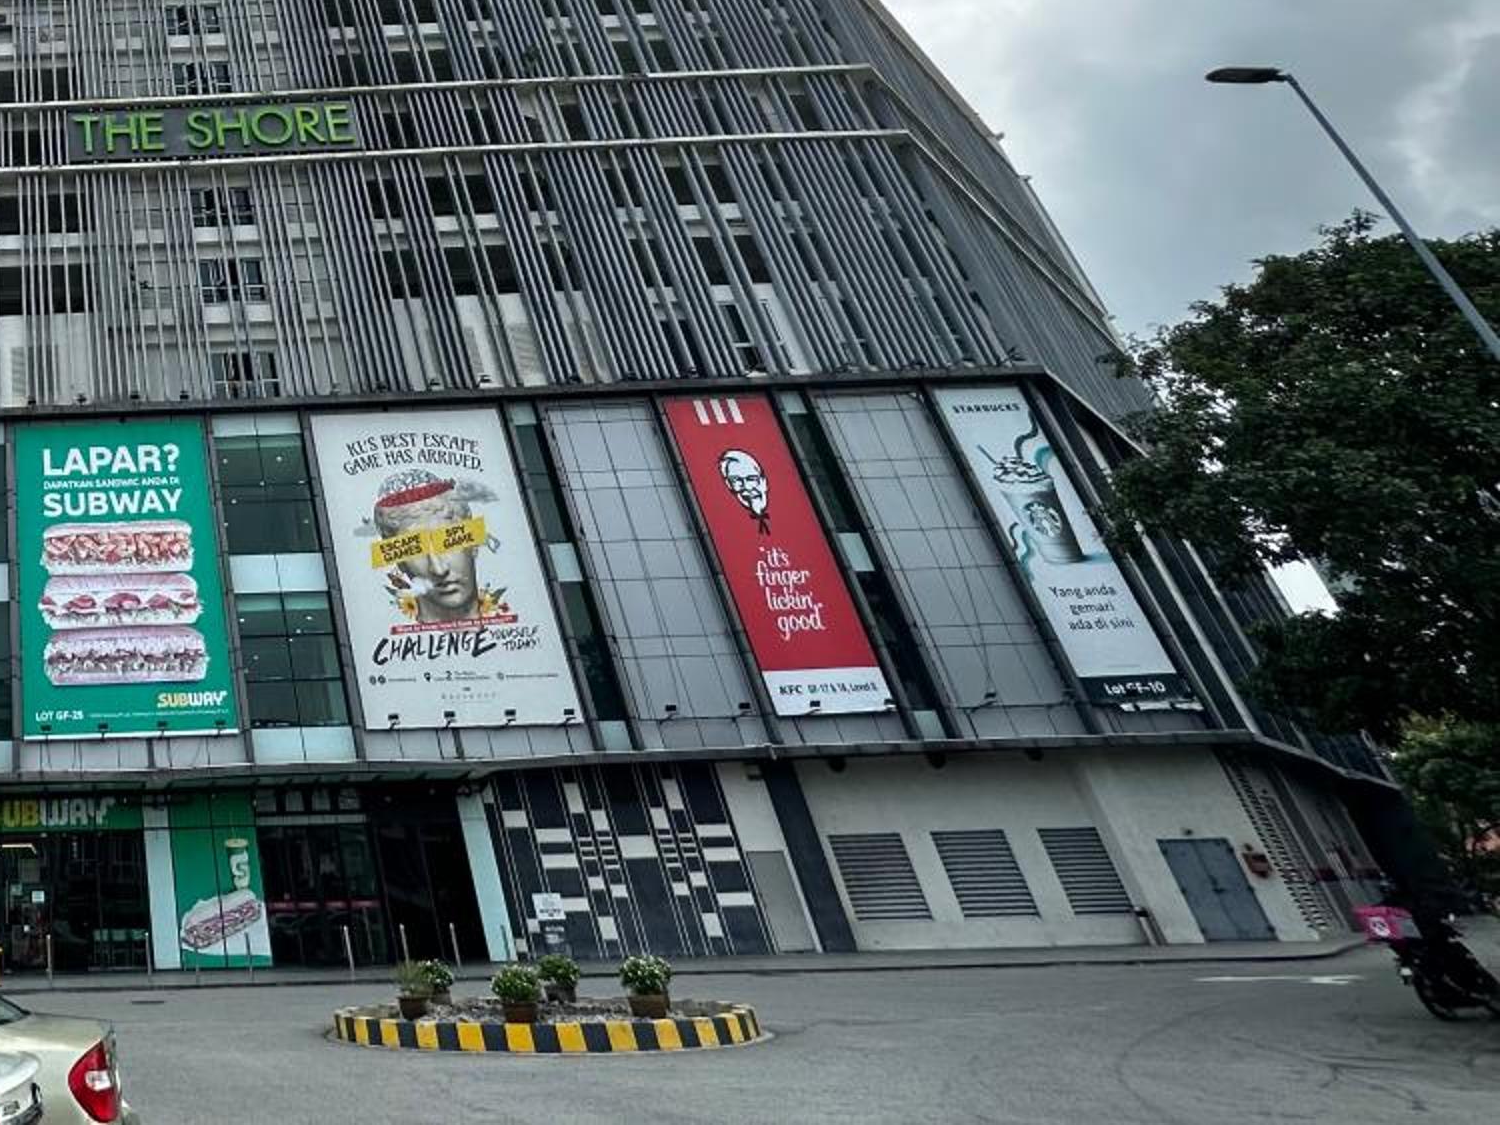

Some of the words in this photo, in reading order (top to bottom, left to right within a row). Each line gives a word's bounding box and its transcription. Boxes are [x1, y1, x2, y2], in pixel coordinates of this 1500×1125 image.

[73, 112, 165, 154] THE
[186, 103, 356, 149] SHORE
[380, 432, 418, 449] BEST
[421, 432, 481, 456] ESCAPE
[42, 443, 181, 476] LAPAR?
[343, 453, 382, 475] GAME
[384, 448, 415, 466] HAS
[43, 488, 183, 517] SUBWAY
[379, 533, 421, 554] ESCAPE
[756, 561, 811, 593] finger
[1049, 586, 1085, 599] Yang
[1085, 583, 1116, 596] anda
[373, 627, 497, 665] CHALLENGE
[156, 690, 228, 708] SUBWAY
[780, 683, 803, 694] KFC
[35, 711, 55, 722] LOT
